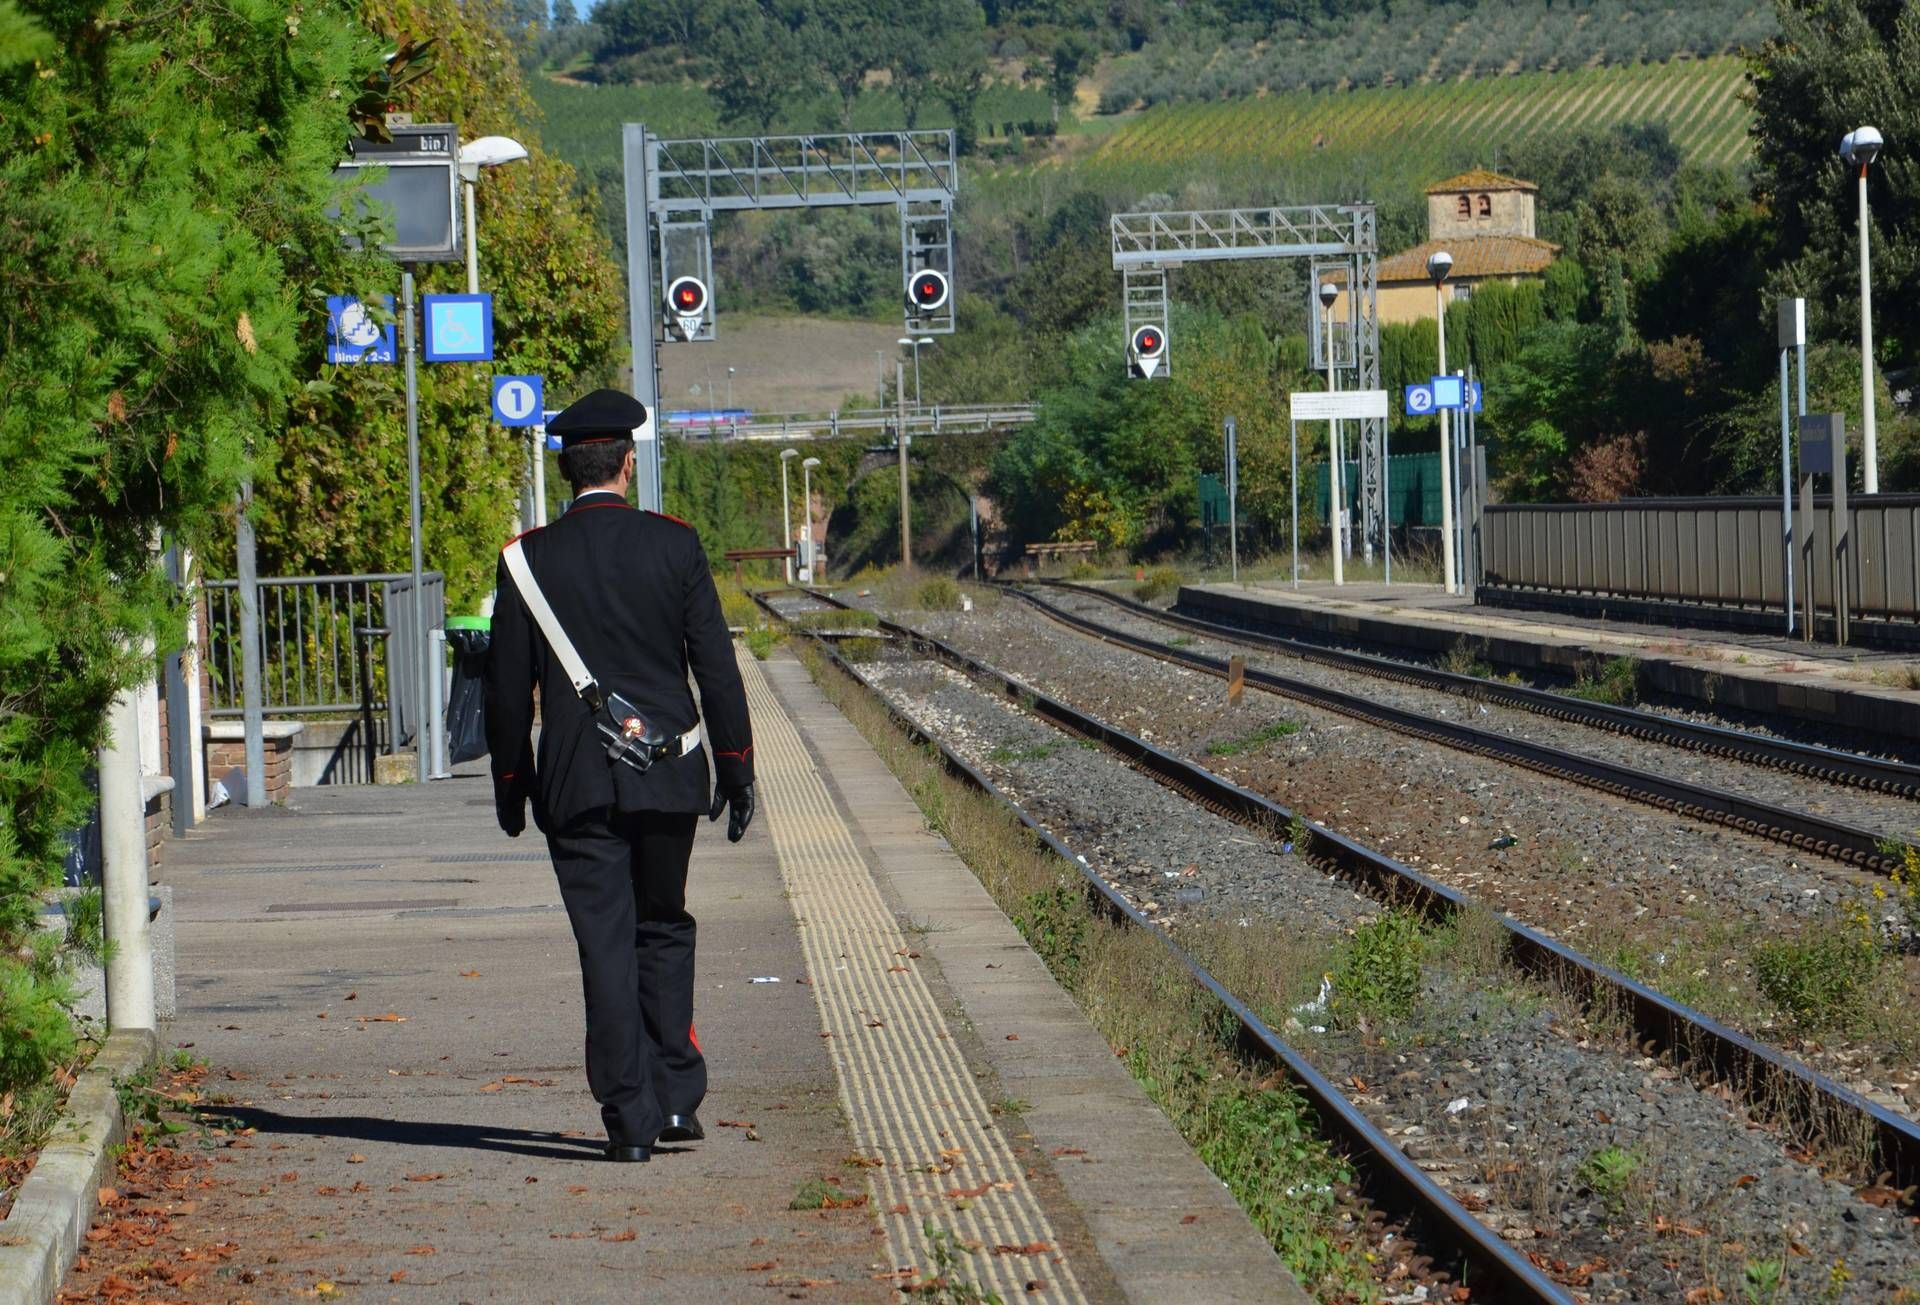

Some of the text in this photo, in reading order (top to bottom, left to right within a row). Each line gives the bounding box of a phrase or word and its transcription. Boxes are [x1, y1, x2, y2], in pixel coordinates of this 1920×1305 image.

[420, 135, 441, 151] bin
[683, 319, 697, 331] 60
[370, 351, 391, 362] 2-3
[511, 388, 522, 412] 1
[1415, 392, 1427, 408] 2
